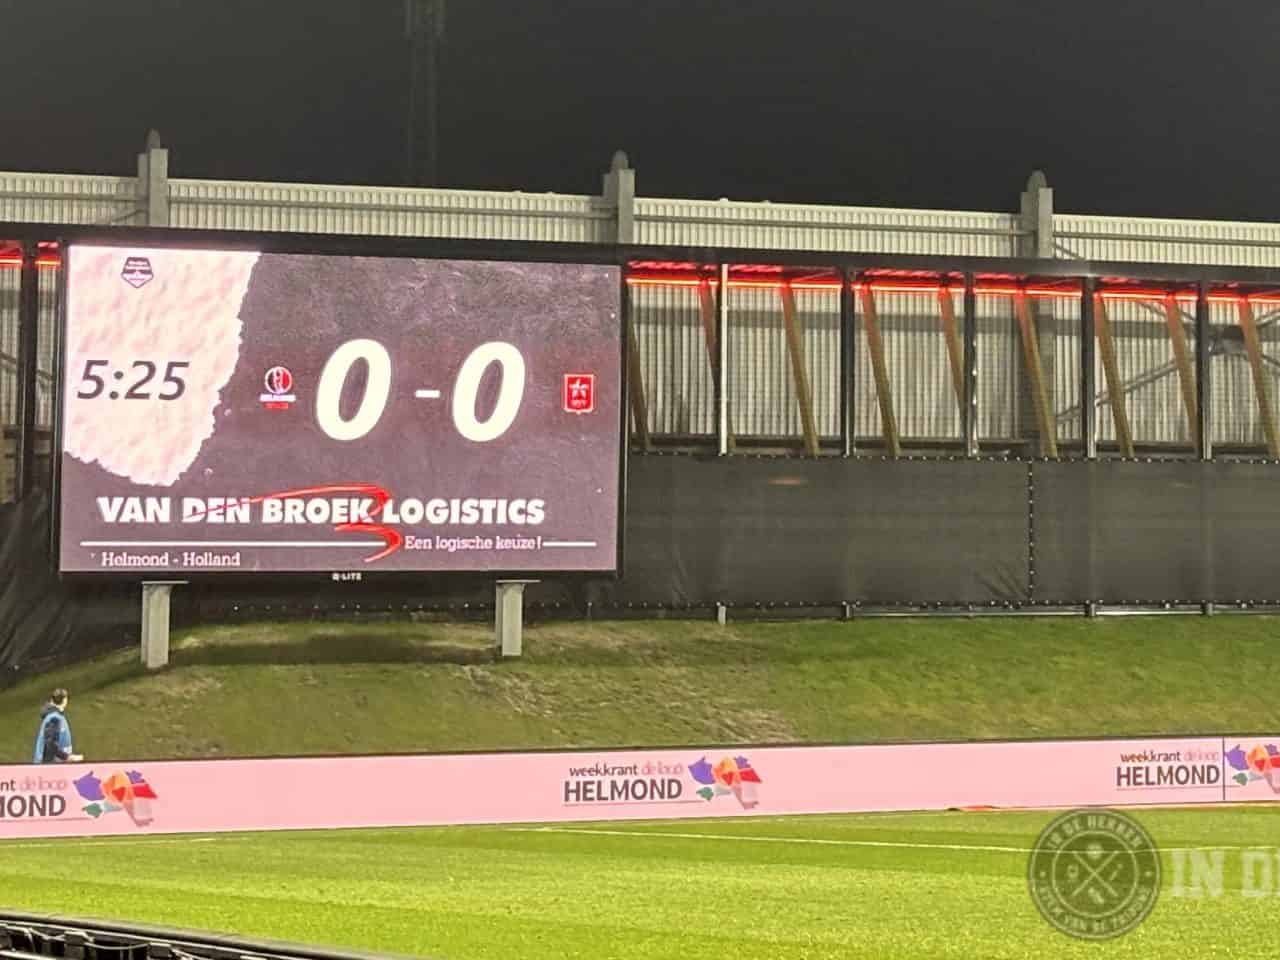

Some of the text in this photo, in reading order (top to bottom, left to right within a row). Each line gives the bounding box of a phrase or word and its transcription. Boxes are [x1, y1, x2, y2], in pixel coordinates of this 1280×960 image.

[77, 359, 190, 401] 5:25
[316, 338, 392, 441] 0
[451, 341, 526, 442] 0
[96, 496, 545, 525] VAN DEN BROEK LOGISTICS
[404, 535, 432, 550] Een
[436, 535, 493, 553] logische
[101, 551, 169, 567] Helmond
[183, 551, 241, 567] Holland
[569, 761, 638, 777] weekkrant
[1116, 764, 1220, 786] HELMOND
[564, 779, 682, 802] HELMOND
[0, 794, 66, 818] OND
